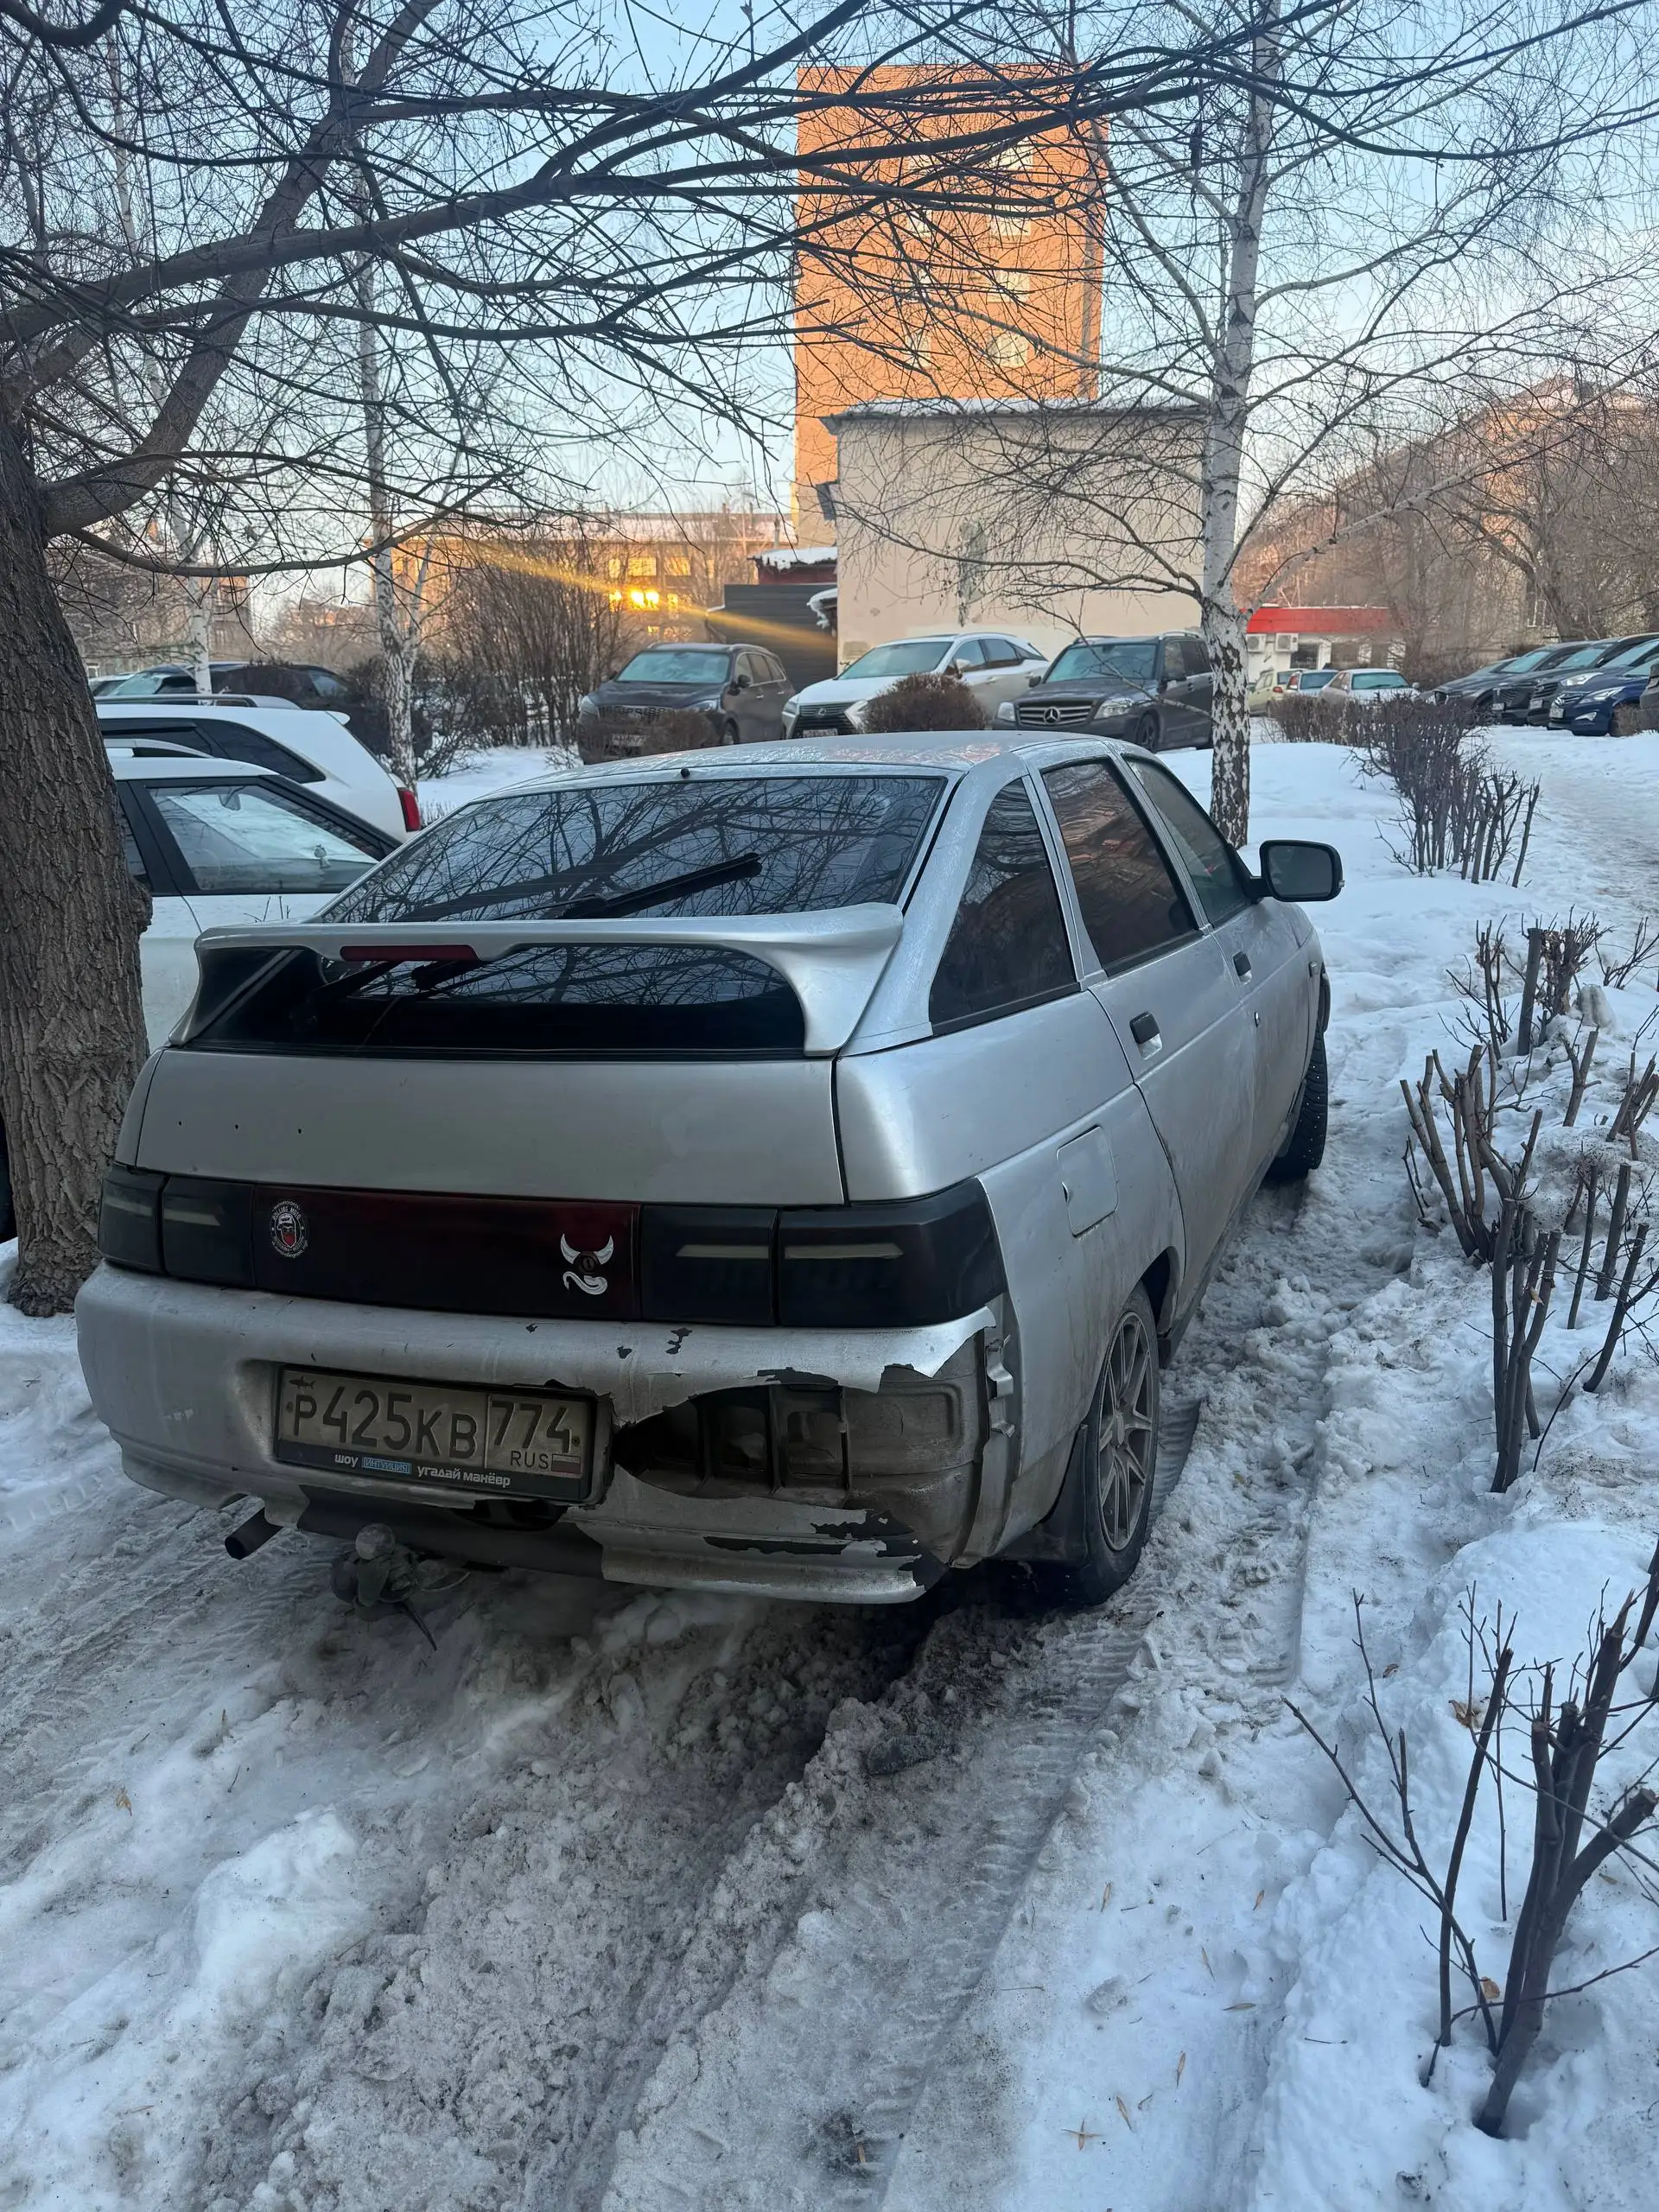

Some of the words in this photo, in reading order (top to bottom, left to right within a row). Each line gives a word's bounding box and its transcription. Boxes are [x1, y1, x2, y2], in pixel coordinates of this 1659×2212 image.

[491, 1401, 573, 1453] 774
[334, 1453, 359, 1468] шоу
[416, 1465, 461, 1480] угадай
[463, 1471, 511, 1488] манёвр
[511, 1451, 549, 1470] RUS
